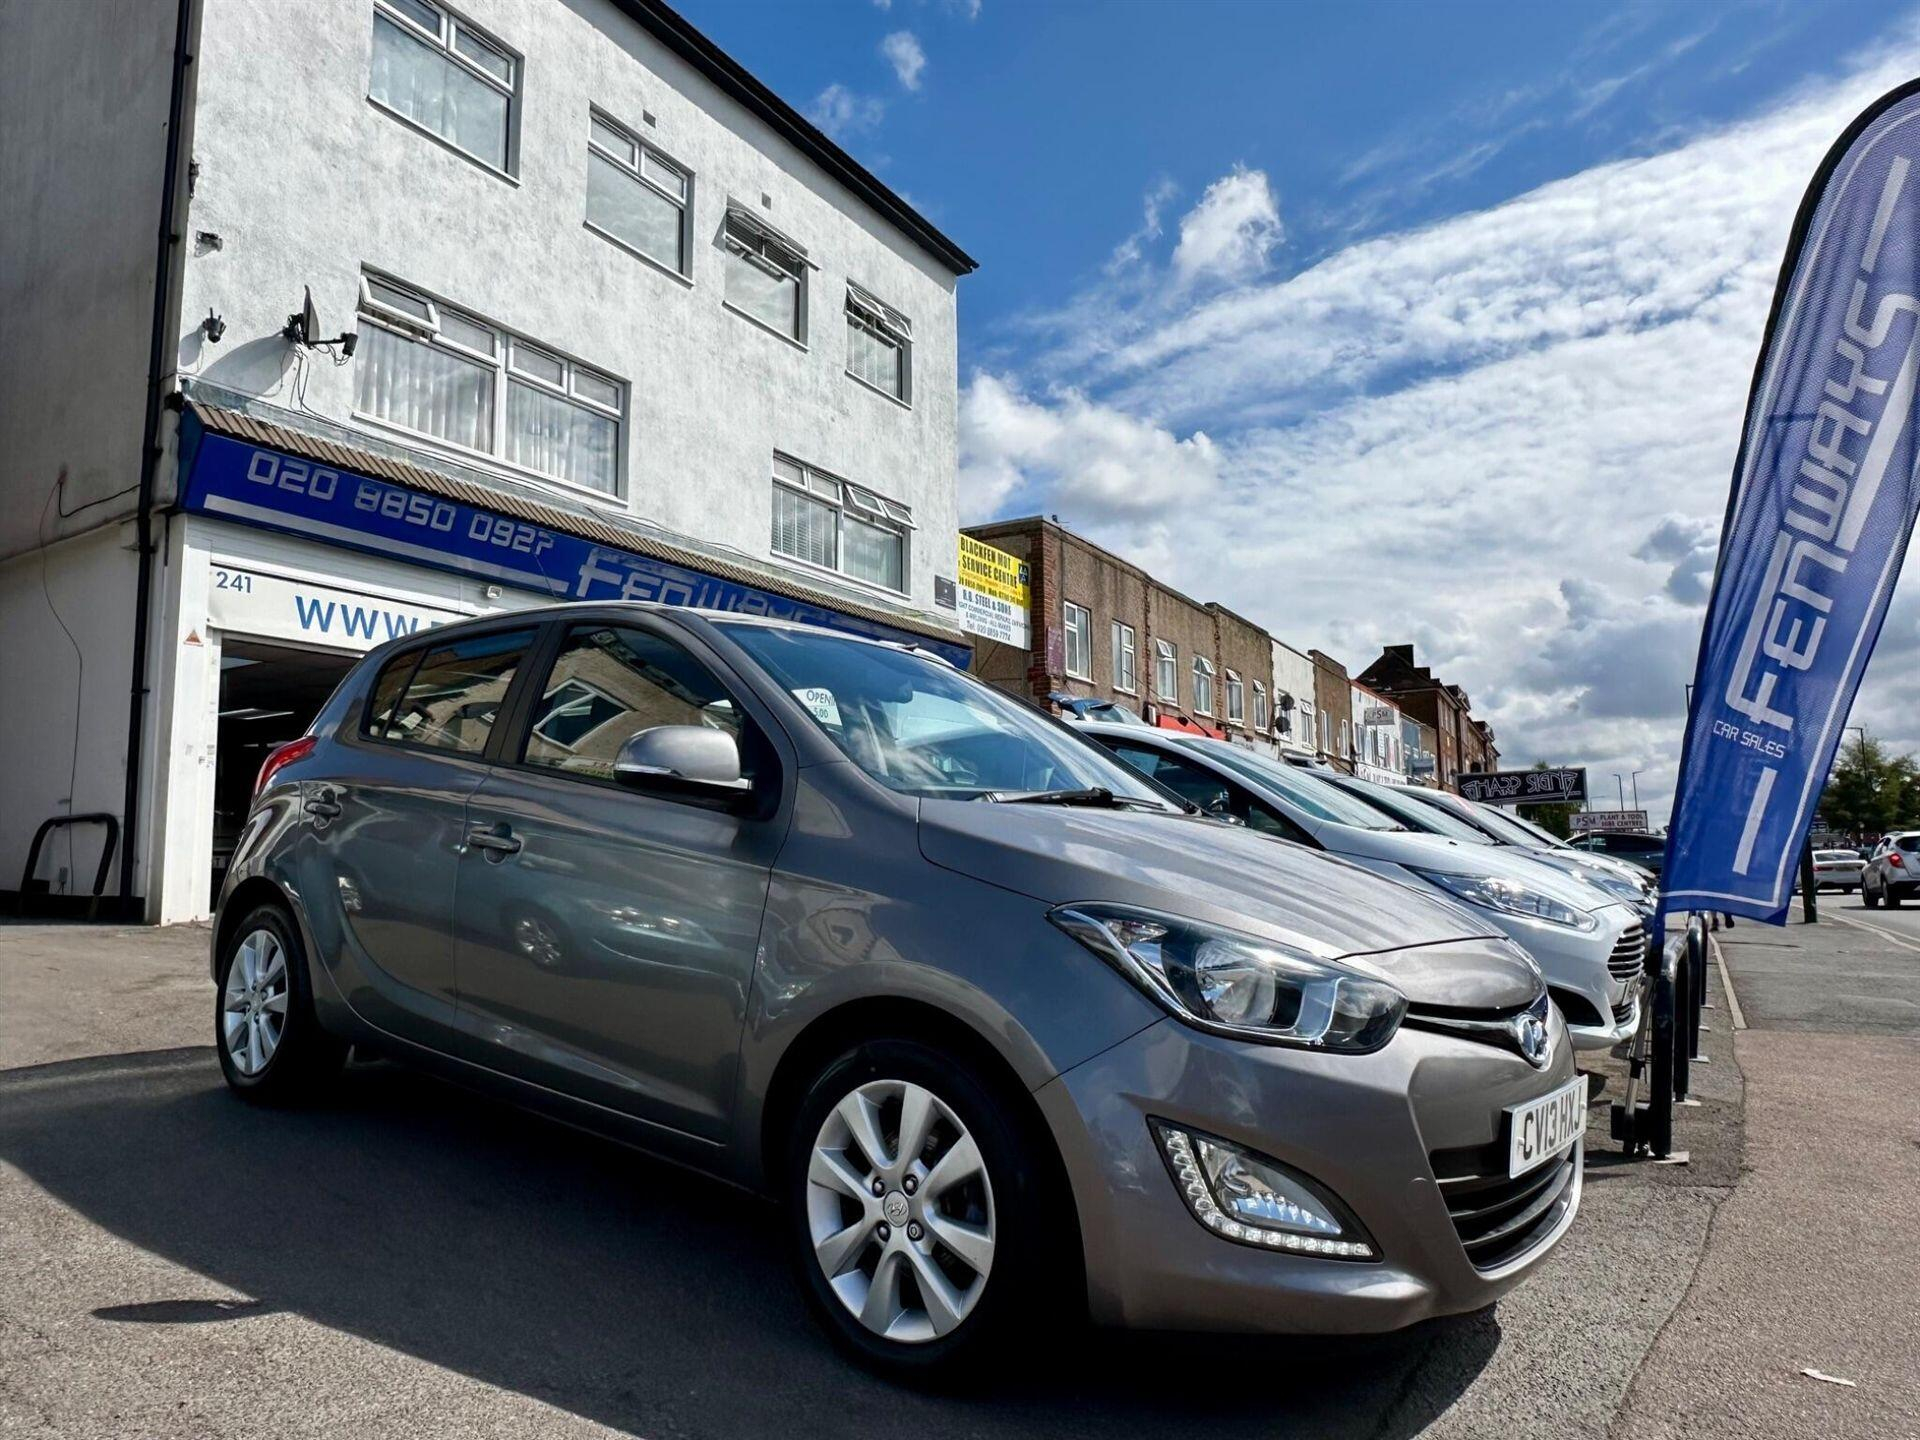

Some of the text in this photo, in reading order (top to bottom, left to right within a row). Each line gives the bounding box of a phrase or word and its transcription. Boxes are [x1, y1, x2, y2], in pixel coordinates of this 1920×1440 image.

[247, 451, 339, 500] 020
[354, 482, 456, 531] 8850
[1726, 280, 1920, 732] FENWAYS
[960, 537, 996, 563] BLACKFEN
[962, 555, 992, 578] SERVICE
[994, 568, 1018, 588] CENTRE
[216, 571, 252, 594] 241
[576, 546, 828, 623] FENWAY
[295, 596, 446, 642] WWW
[1713, 720, 1786, 758] CAR SALES
[1523, 1086, 1581, 1161] CV13 HXJ
